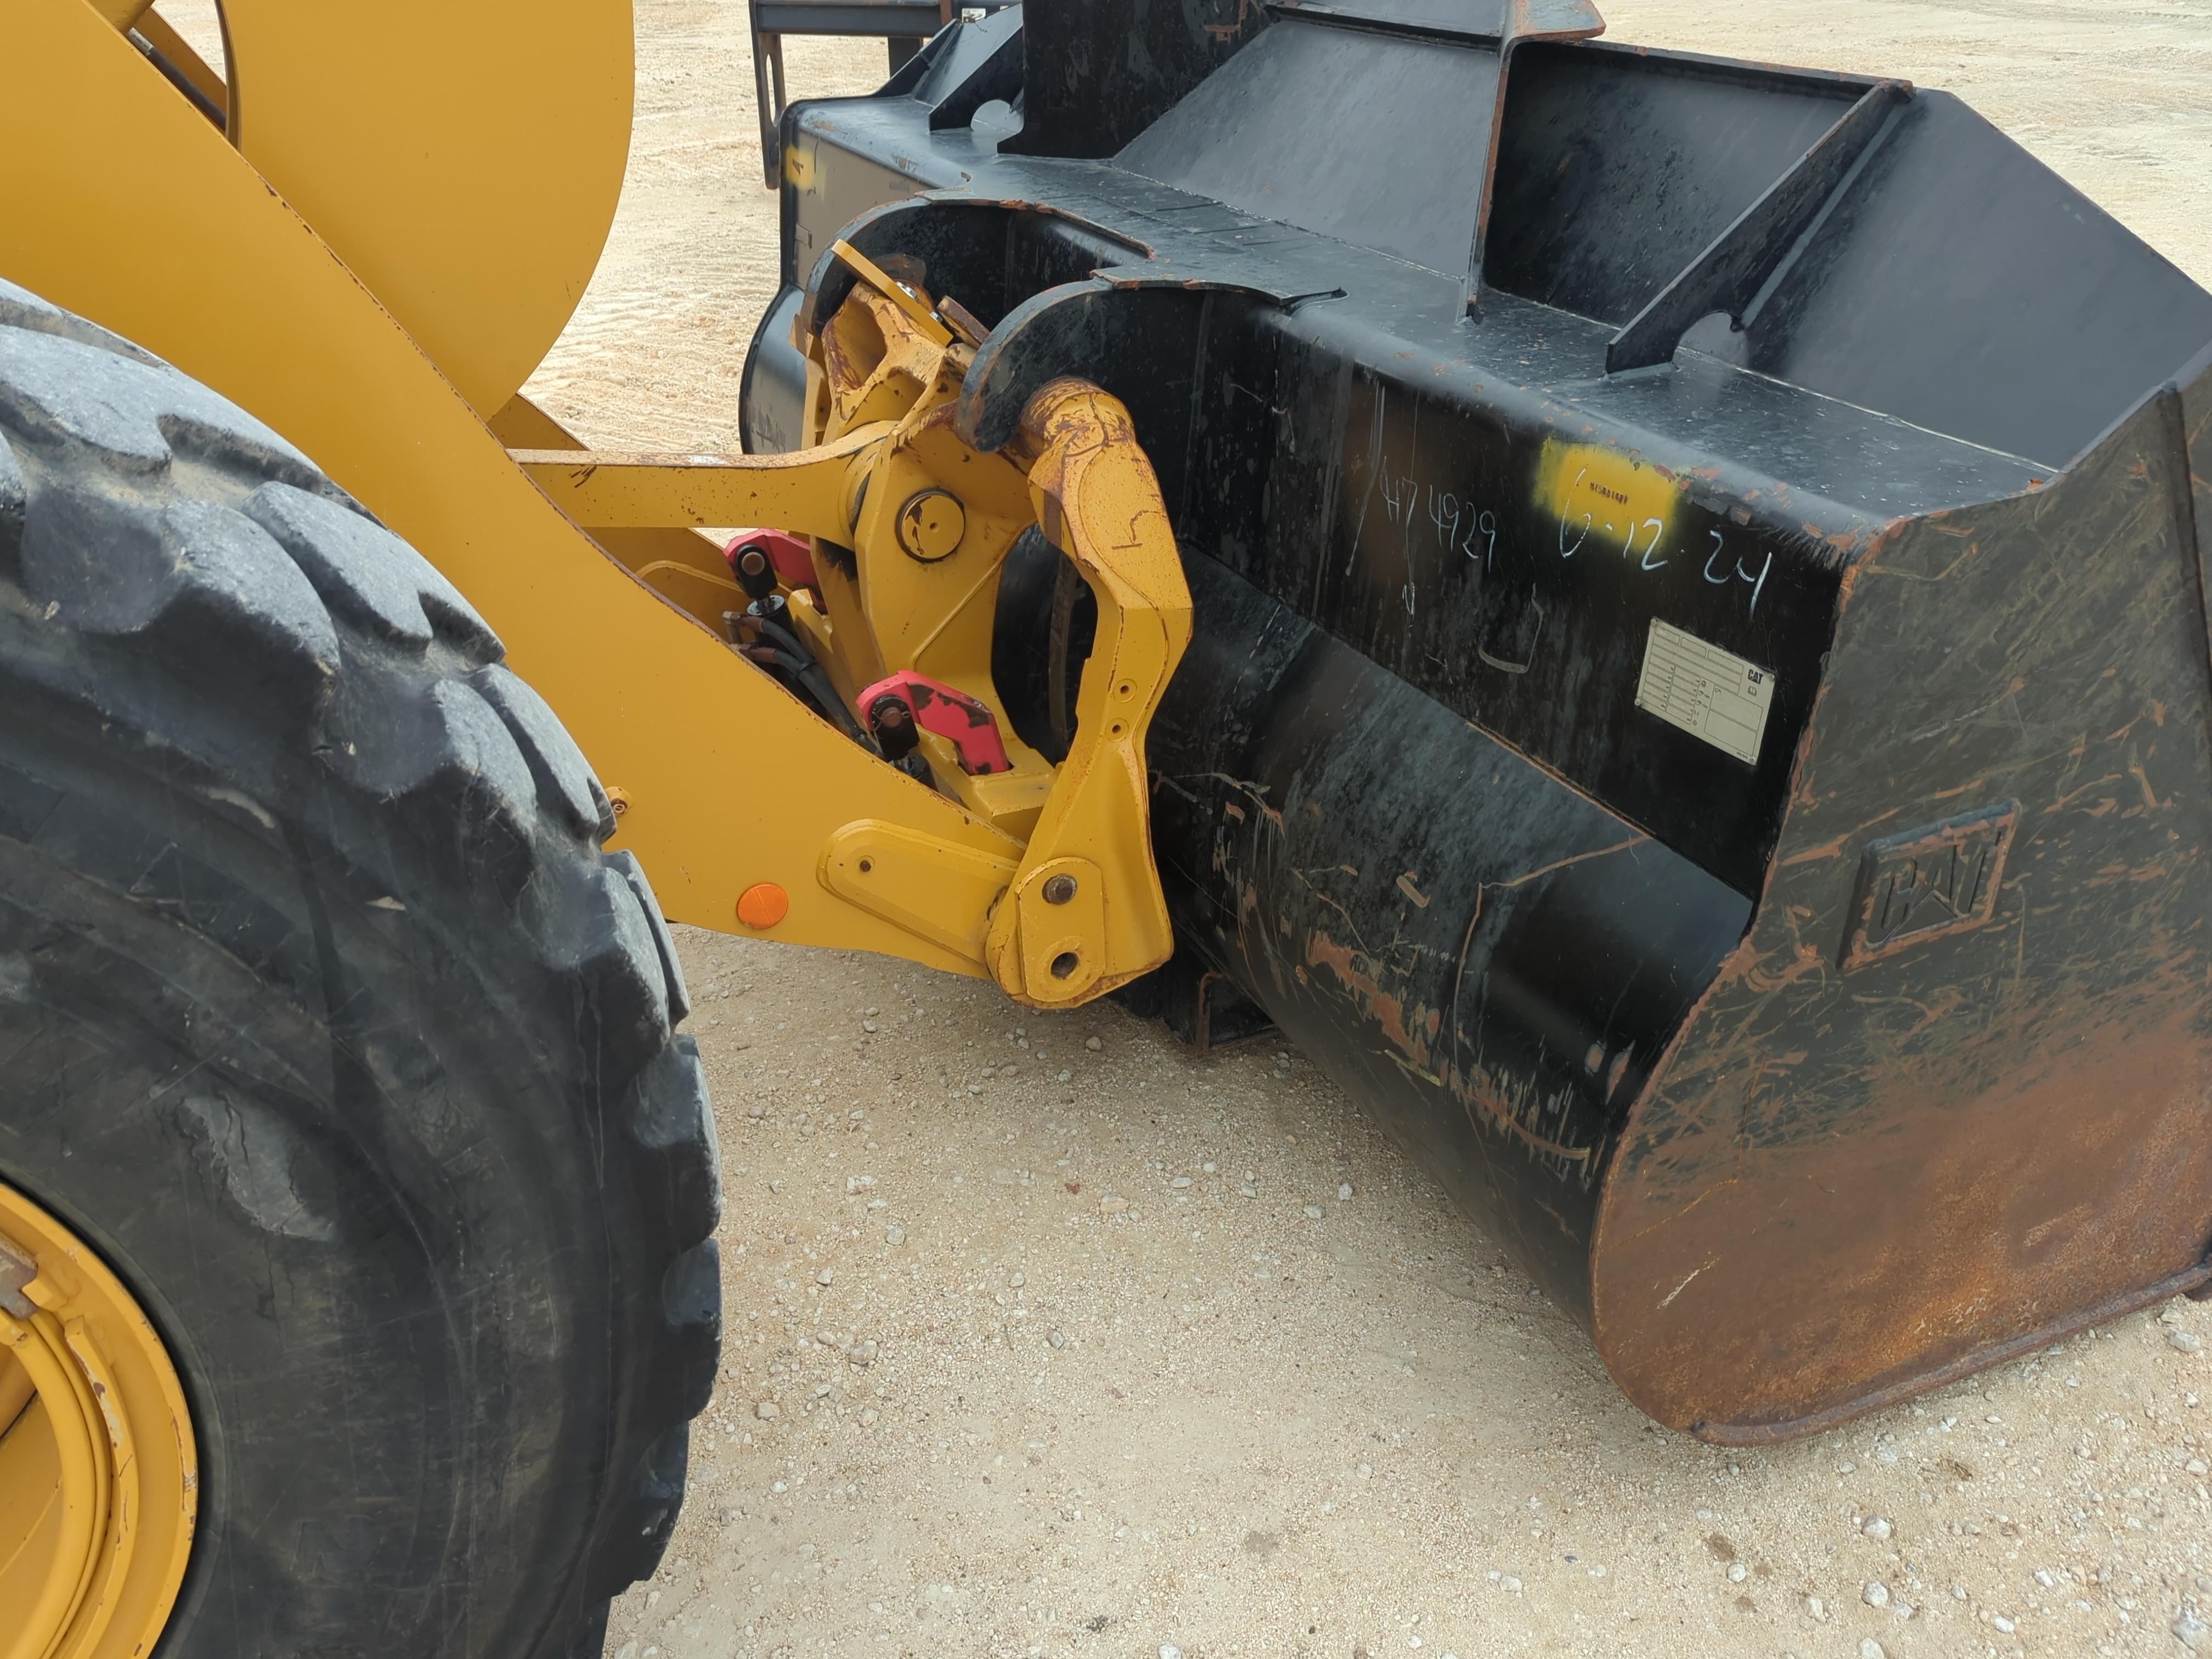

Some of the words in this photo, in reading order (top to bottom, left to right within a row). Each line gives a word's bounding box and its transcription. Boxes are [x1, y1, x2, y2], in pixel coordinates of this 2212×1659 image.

[1429, 484, 1496, 573] 4929
[1748, 668, 1764, 685] CAT
[1865, 828, 2002, 947] CAT
